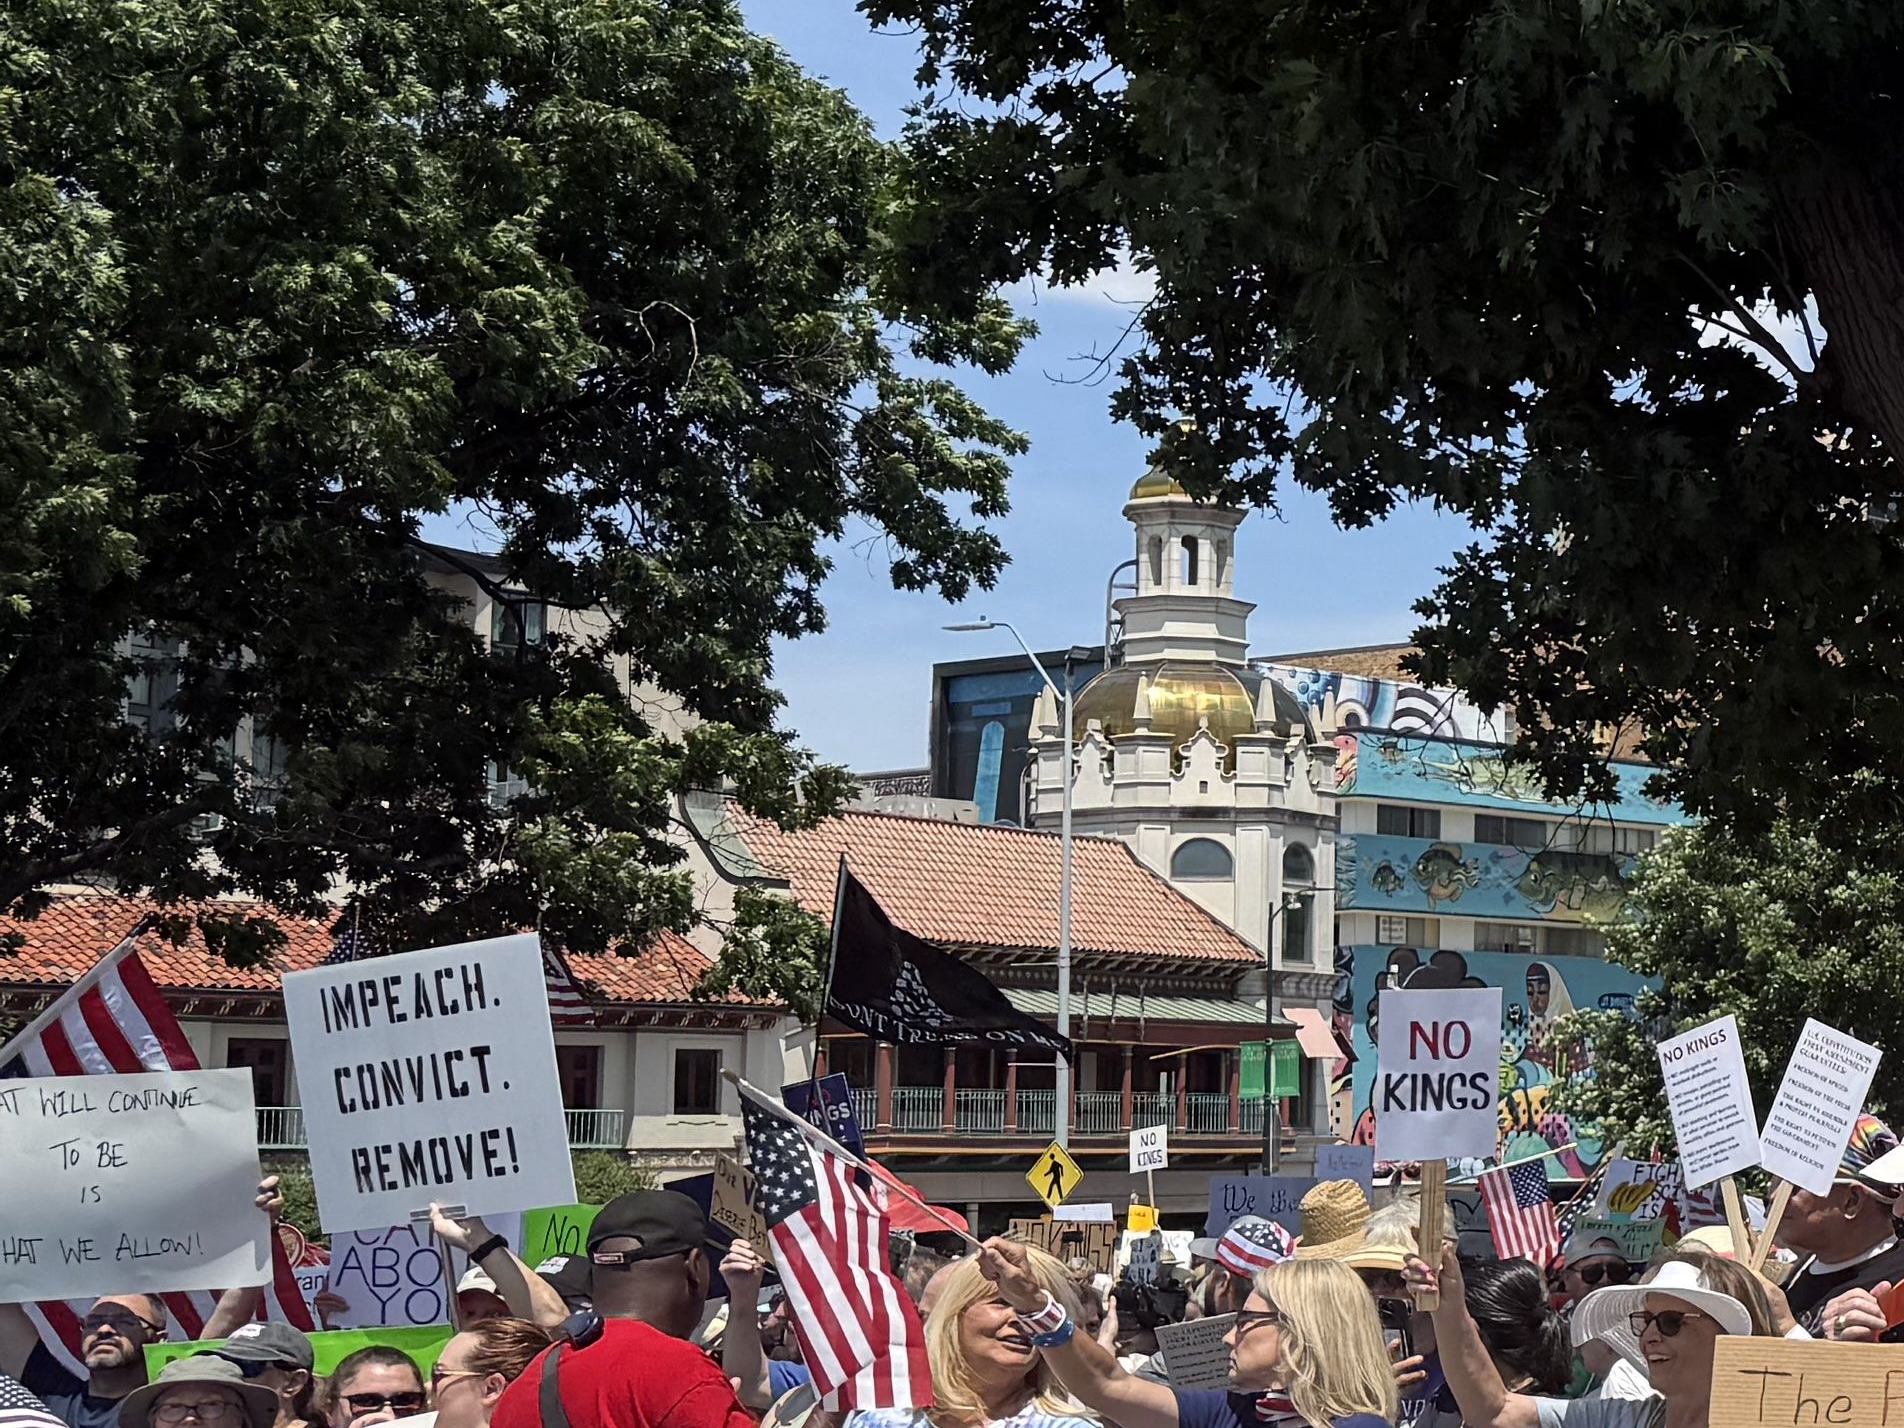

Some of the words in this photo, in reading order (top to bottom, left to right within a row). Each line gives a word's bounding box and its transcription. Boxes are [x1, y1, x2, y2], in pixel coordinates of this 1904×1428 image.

[320, 963, 500, 1033] IMPEACH.
[1410, 1021, 1471, 1060] NO
[1663, 1046, 1684, 1066] NO
[1686, 1028, 1727, 1056] KINGS
[334, 1045, 511, 1114] CONVICT.
[1384, 1072, 1490, 1112] KINGS
[40, 1087, 97, 1117] WILL
[108, 1086, 202, 1113] CONTINUE
[1137, 1149, 1162, 1167] KINGS
[1140, 1132, 1156, 1148] NO
[352, 1126, 519, 1193] REMOVE!
[81, 1185, 101, 1203] IS
[1224, 1183, 1255, 1213] We
[59, 1239, 100, 1264] WE
[116, 1232, 203, 1260] ALLOW!
[1739, 1366, 1852, 1426] The
